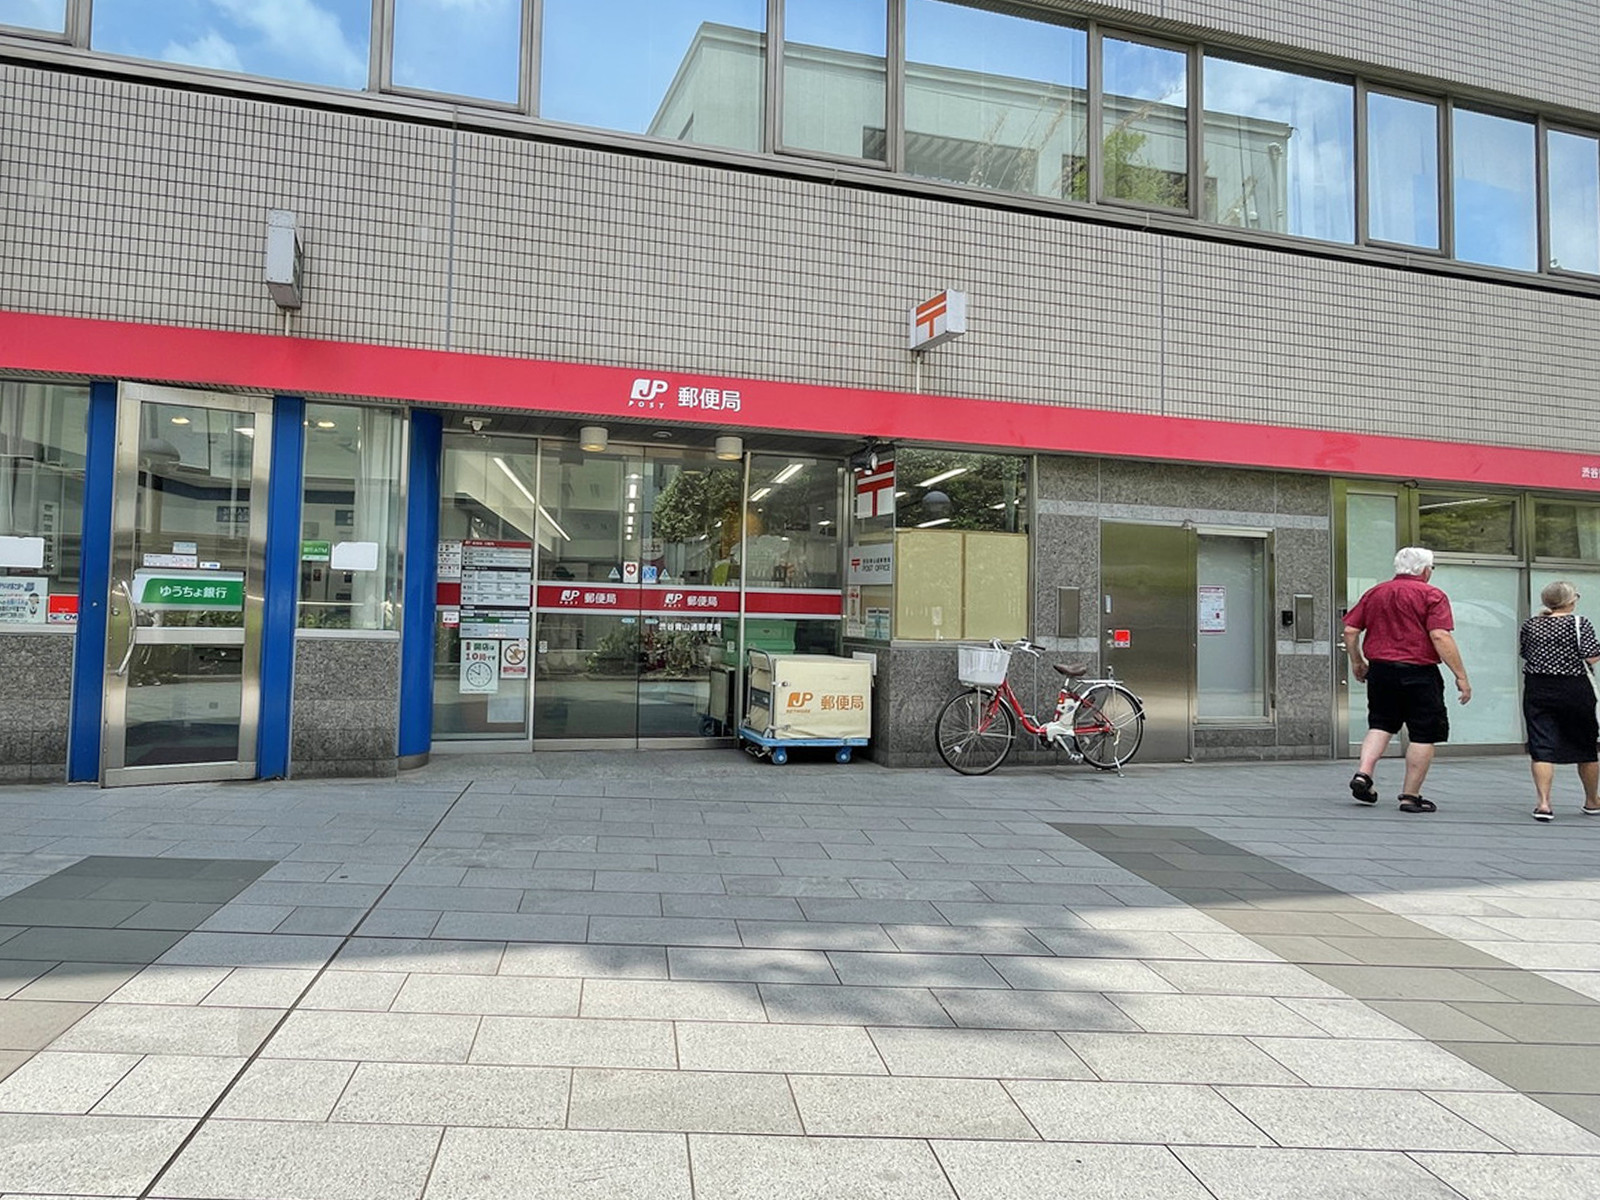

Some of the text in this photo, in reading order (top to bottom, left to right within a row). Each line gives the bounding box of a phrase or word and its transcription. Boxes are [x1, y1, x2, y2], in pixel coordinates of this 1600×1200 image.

[630, 378, 741, 412] JP 郵便局
[628, 400, 664, 409] POST
[1581, 466, 1600, 479] 渋谷
[159, 586, 227, 598] ゆうちょ銀行
[584, 592, 617, 604] 郵便局
[687, 595, 718, 607] 郵便局
[787, 692, 864, 711] JP 郵便局
